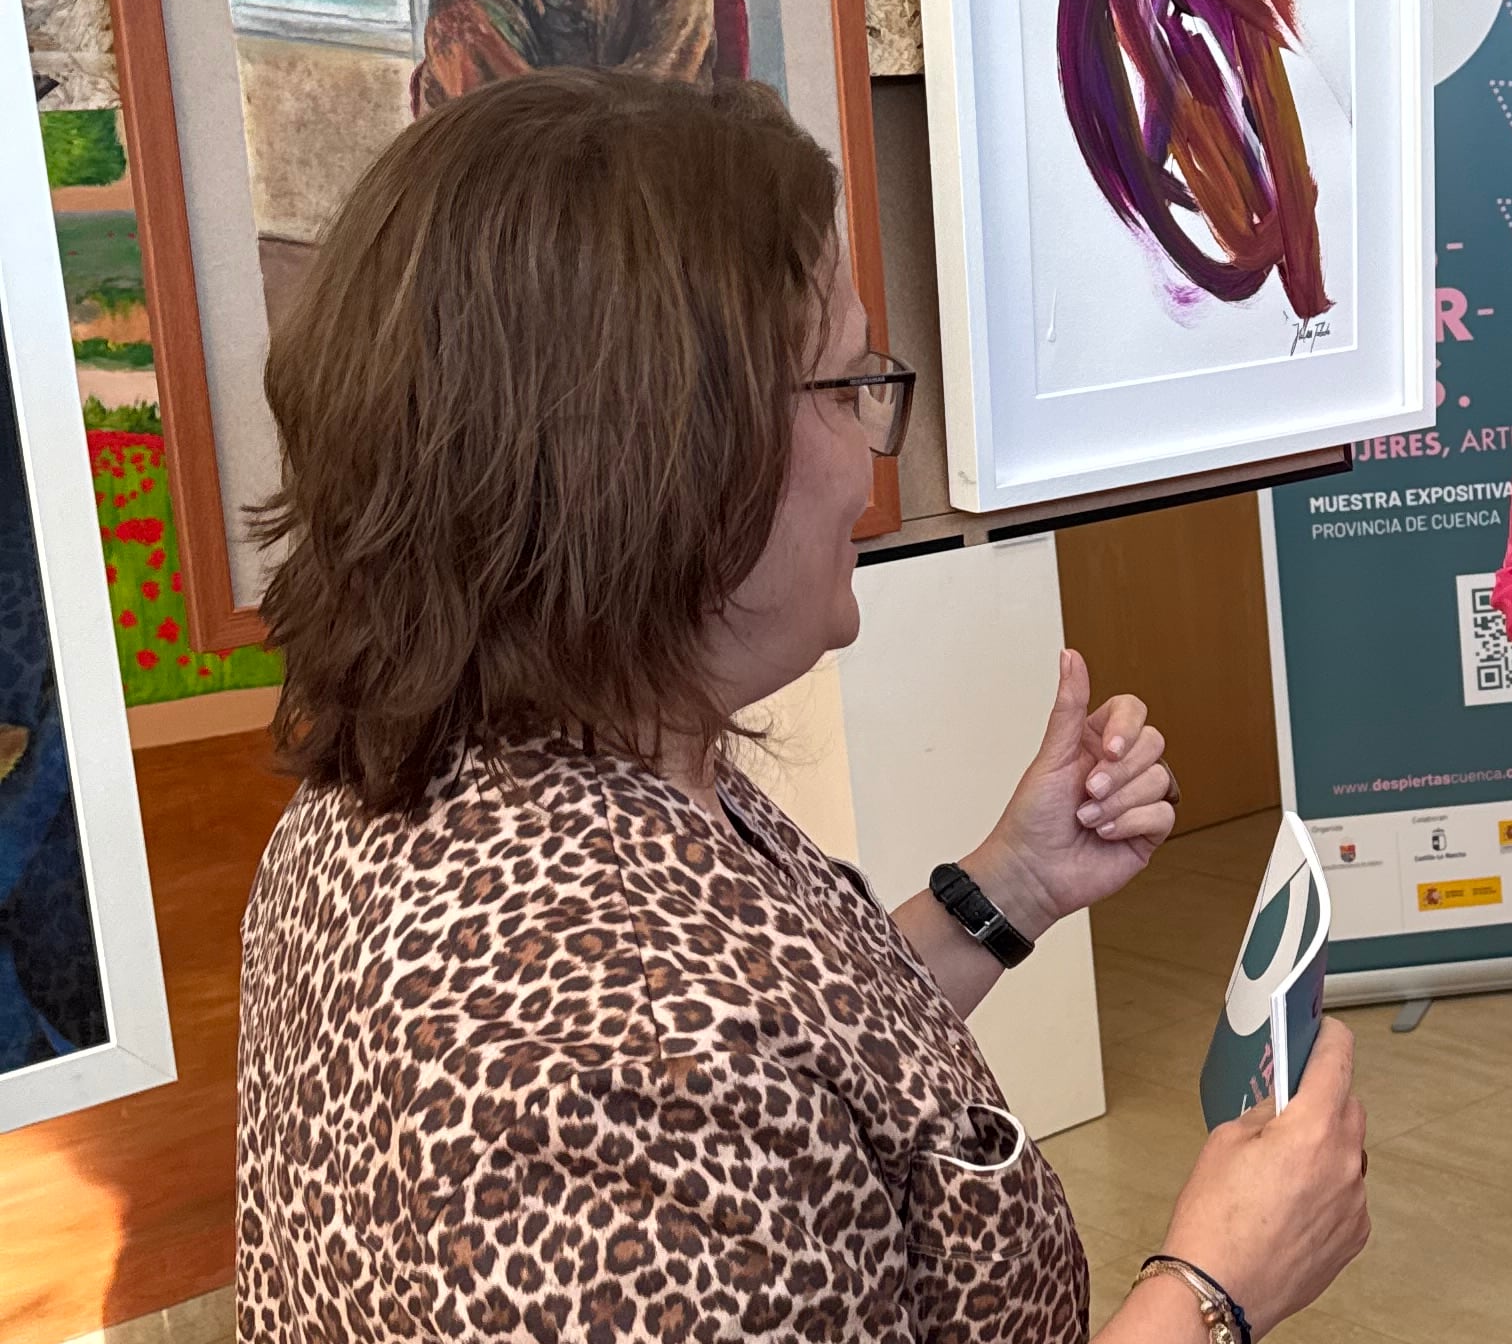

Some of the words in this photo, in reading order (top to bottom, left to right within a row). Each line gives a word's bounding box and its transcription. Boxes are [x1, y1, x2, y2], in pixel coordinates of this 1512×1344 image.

[1309, 490, 1402, 515] MUESTRA
[1311, 517, 1402, 540] PROVINCIA
[1405, 515, 1427, 533] DE
[1431, 509, 1502, 530] CUENCA
